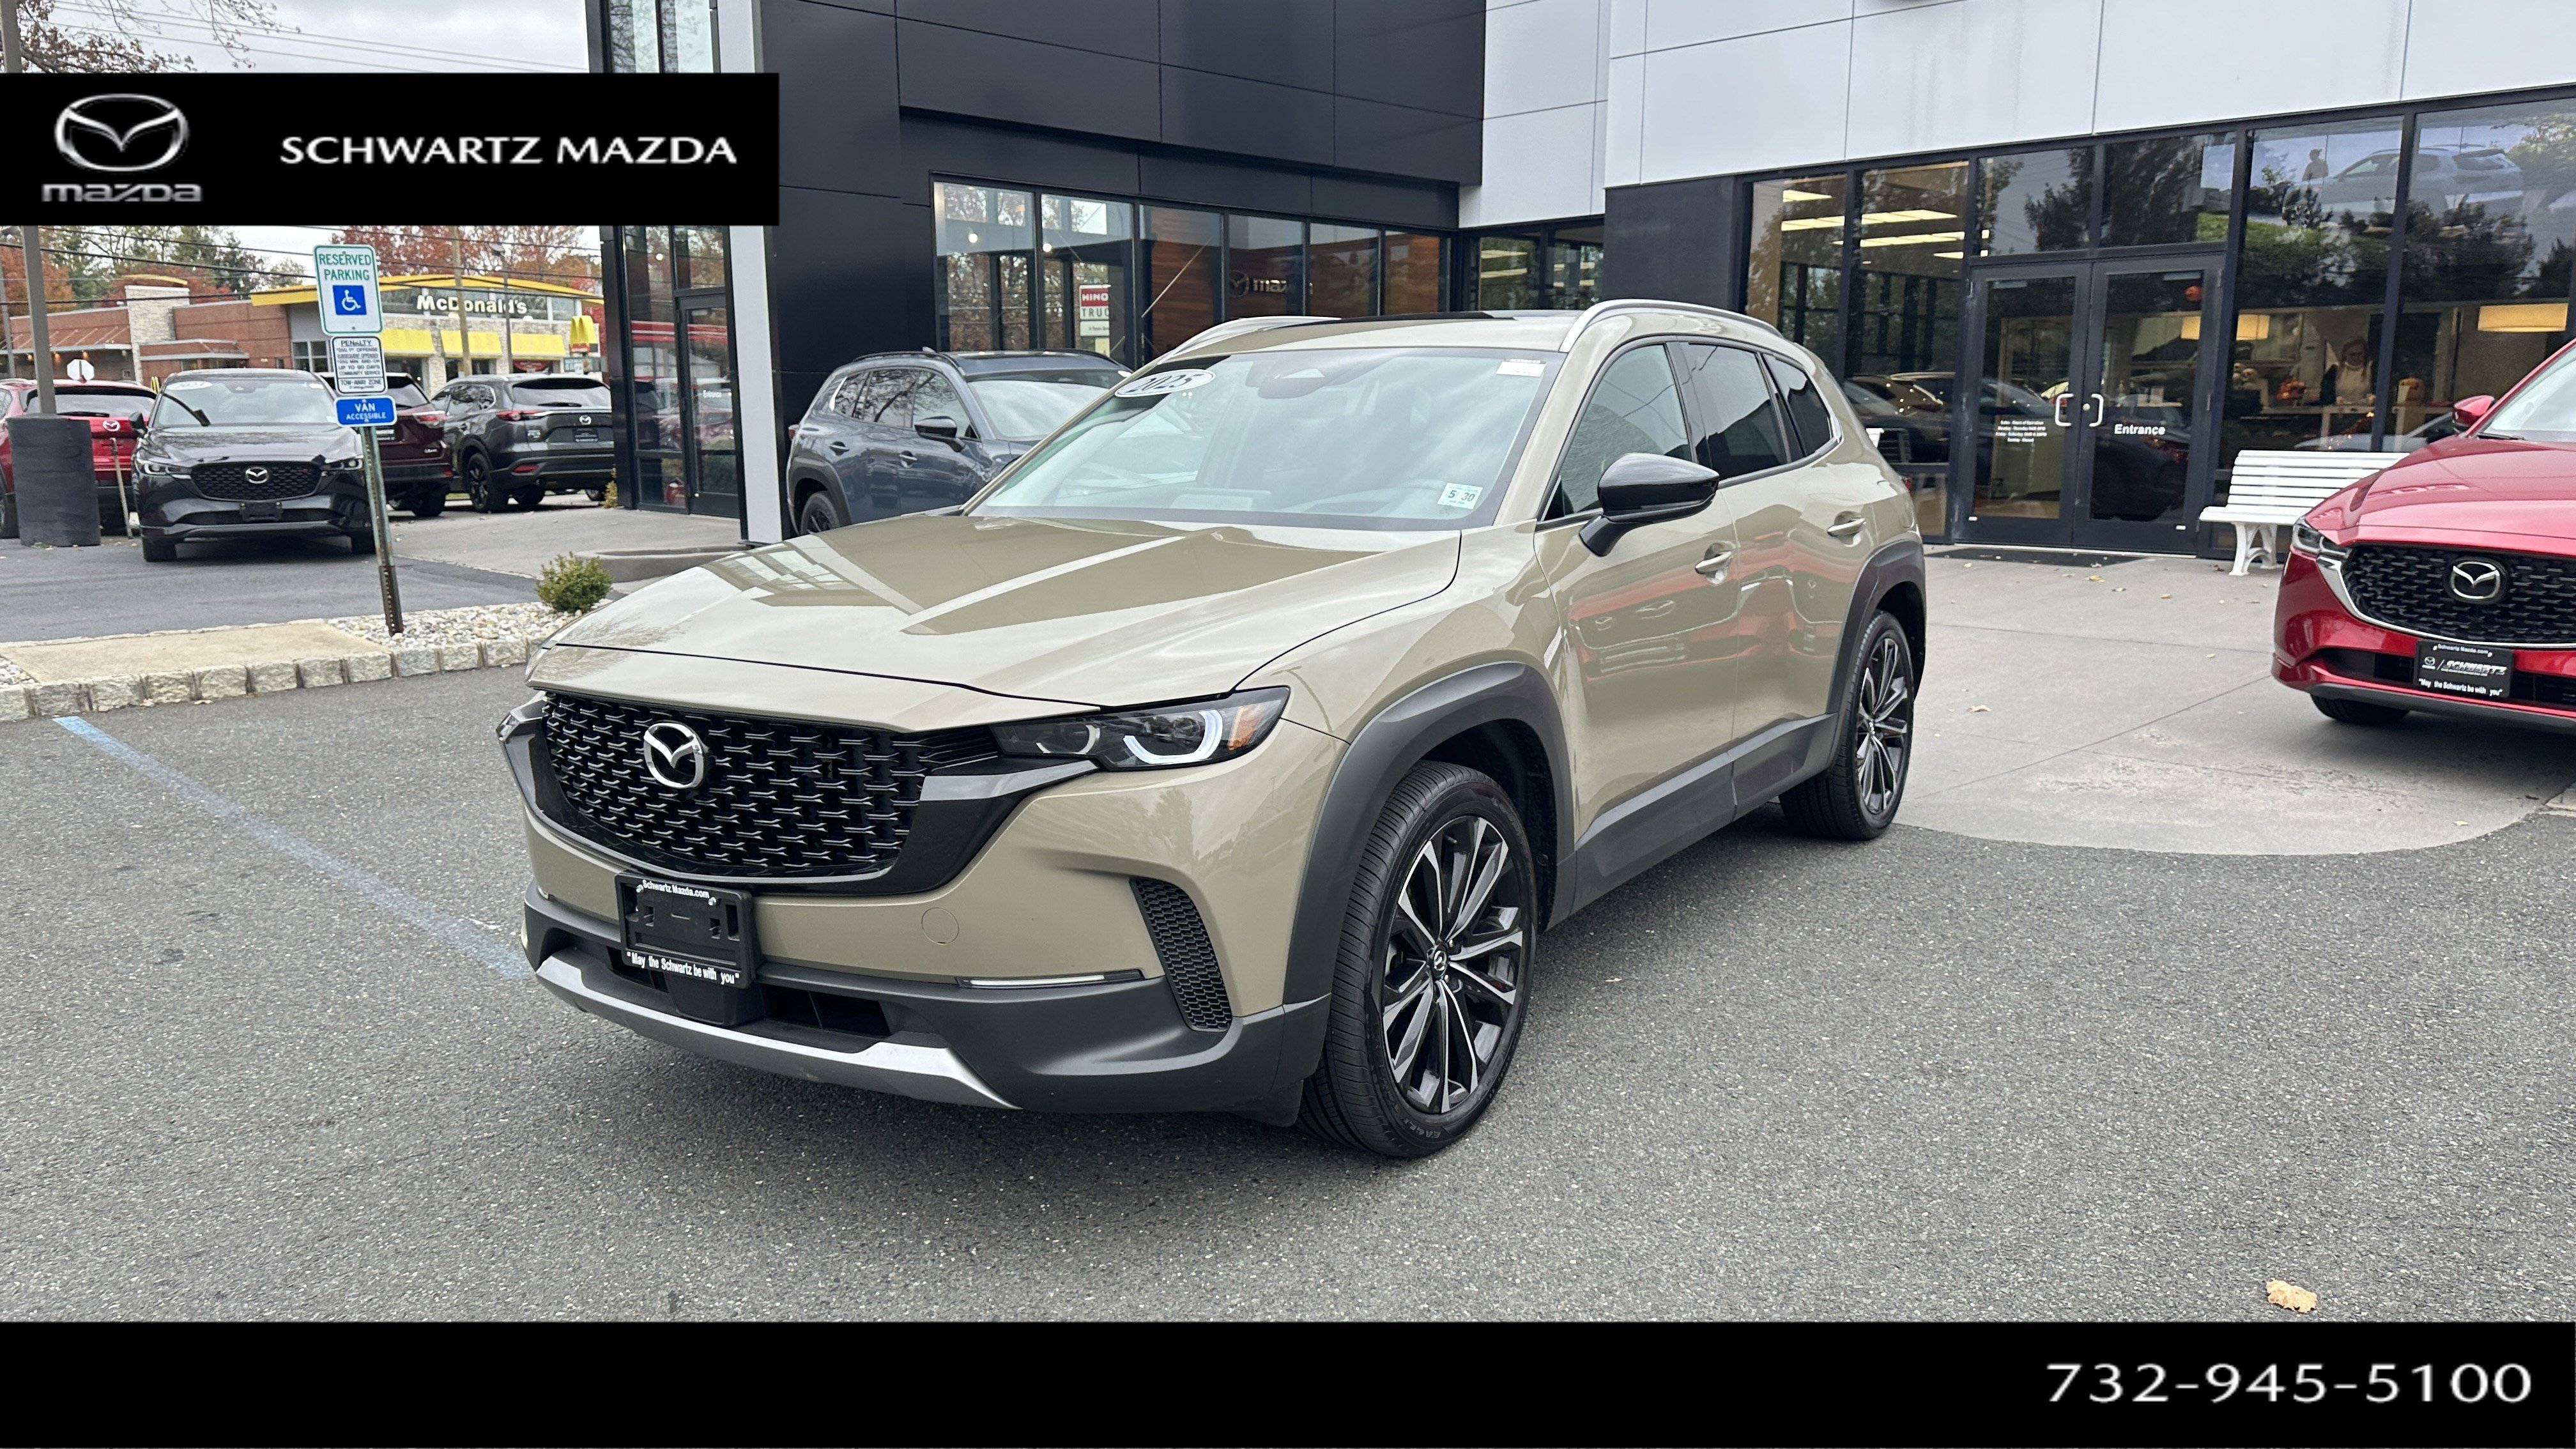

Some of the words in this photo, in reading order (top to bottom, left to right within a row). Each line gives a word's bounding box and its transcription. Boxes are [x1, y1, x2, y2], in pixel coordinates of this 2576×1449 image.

[319, 254, 371, 266] RESERVED
[324, 269, 370, 281] PARKING
[1082, 293, 1109, 302] HINO
[417, 295, 527, 314] McDonald's
[1124, 372, 1205, 394] 2025
[354, 402, 376, 413] VAN
[346, 411, 387, 421] ACCESSIBLE
[2114, 423, 2166, 436] Entrance
[1448, 489, 1457, 499] 5
[1460, 491, 1476, 502] 30
[2442, 659, 2508, 676] SCHWARTZ
[2434, 679, 2443, 689] the
[2443, 680, 2467, 692] Schwartz
[2467, 684, 2475, 693] be
[2474, 686, 2487, 694] with
[642, 879, 671, 893] Schwartz
[648, 955, 659, 969] the
[661, 957, 693, 976] Schwartz
[693, 963, 702, 977] be
[702, 967, 717, 981] with
